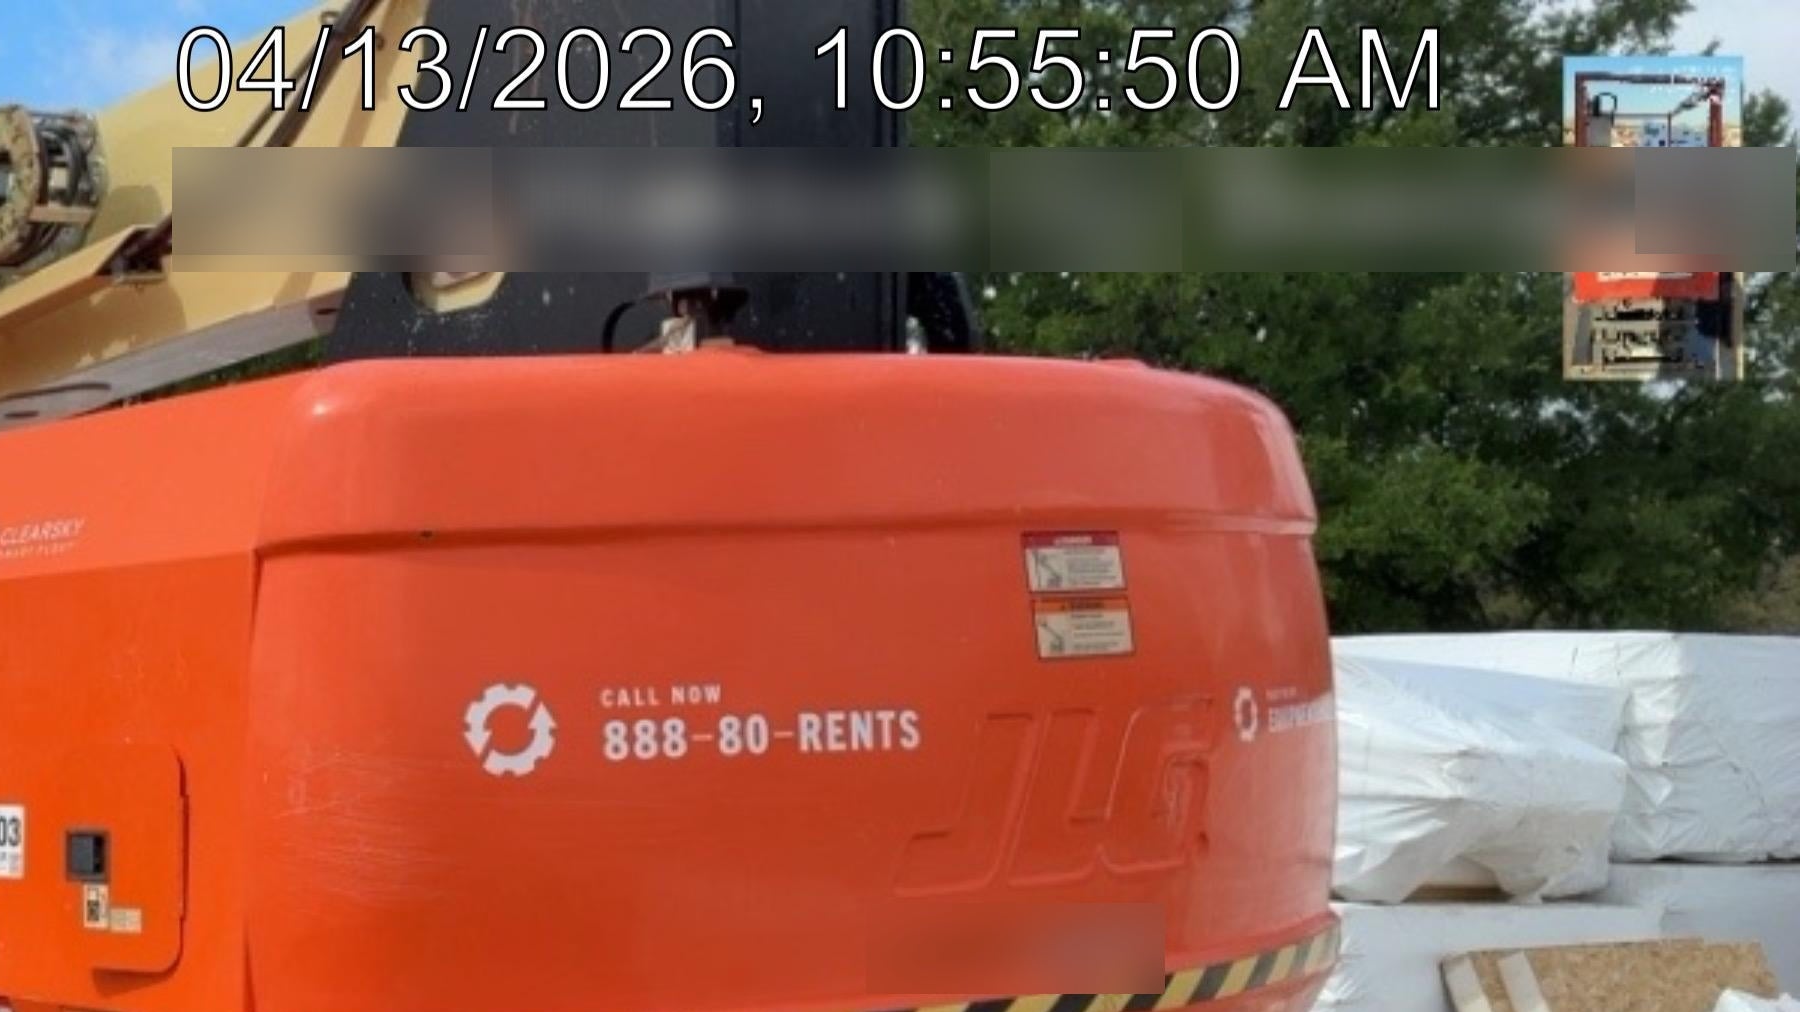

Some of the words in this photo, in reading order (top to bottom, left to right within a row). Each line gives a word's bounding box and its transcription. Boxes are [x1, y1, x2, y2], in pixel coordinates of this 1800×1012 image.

[601, 687, 660, 708] CALL
[671, 683, 722, 704] NOW
[602, 709, 922, 761] 888-80-RENTS
